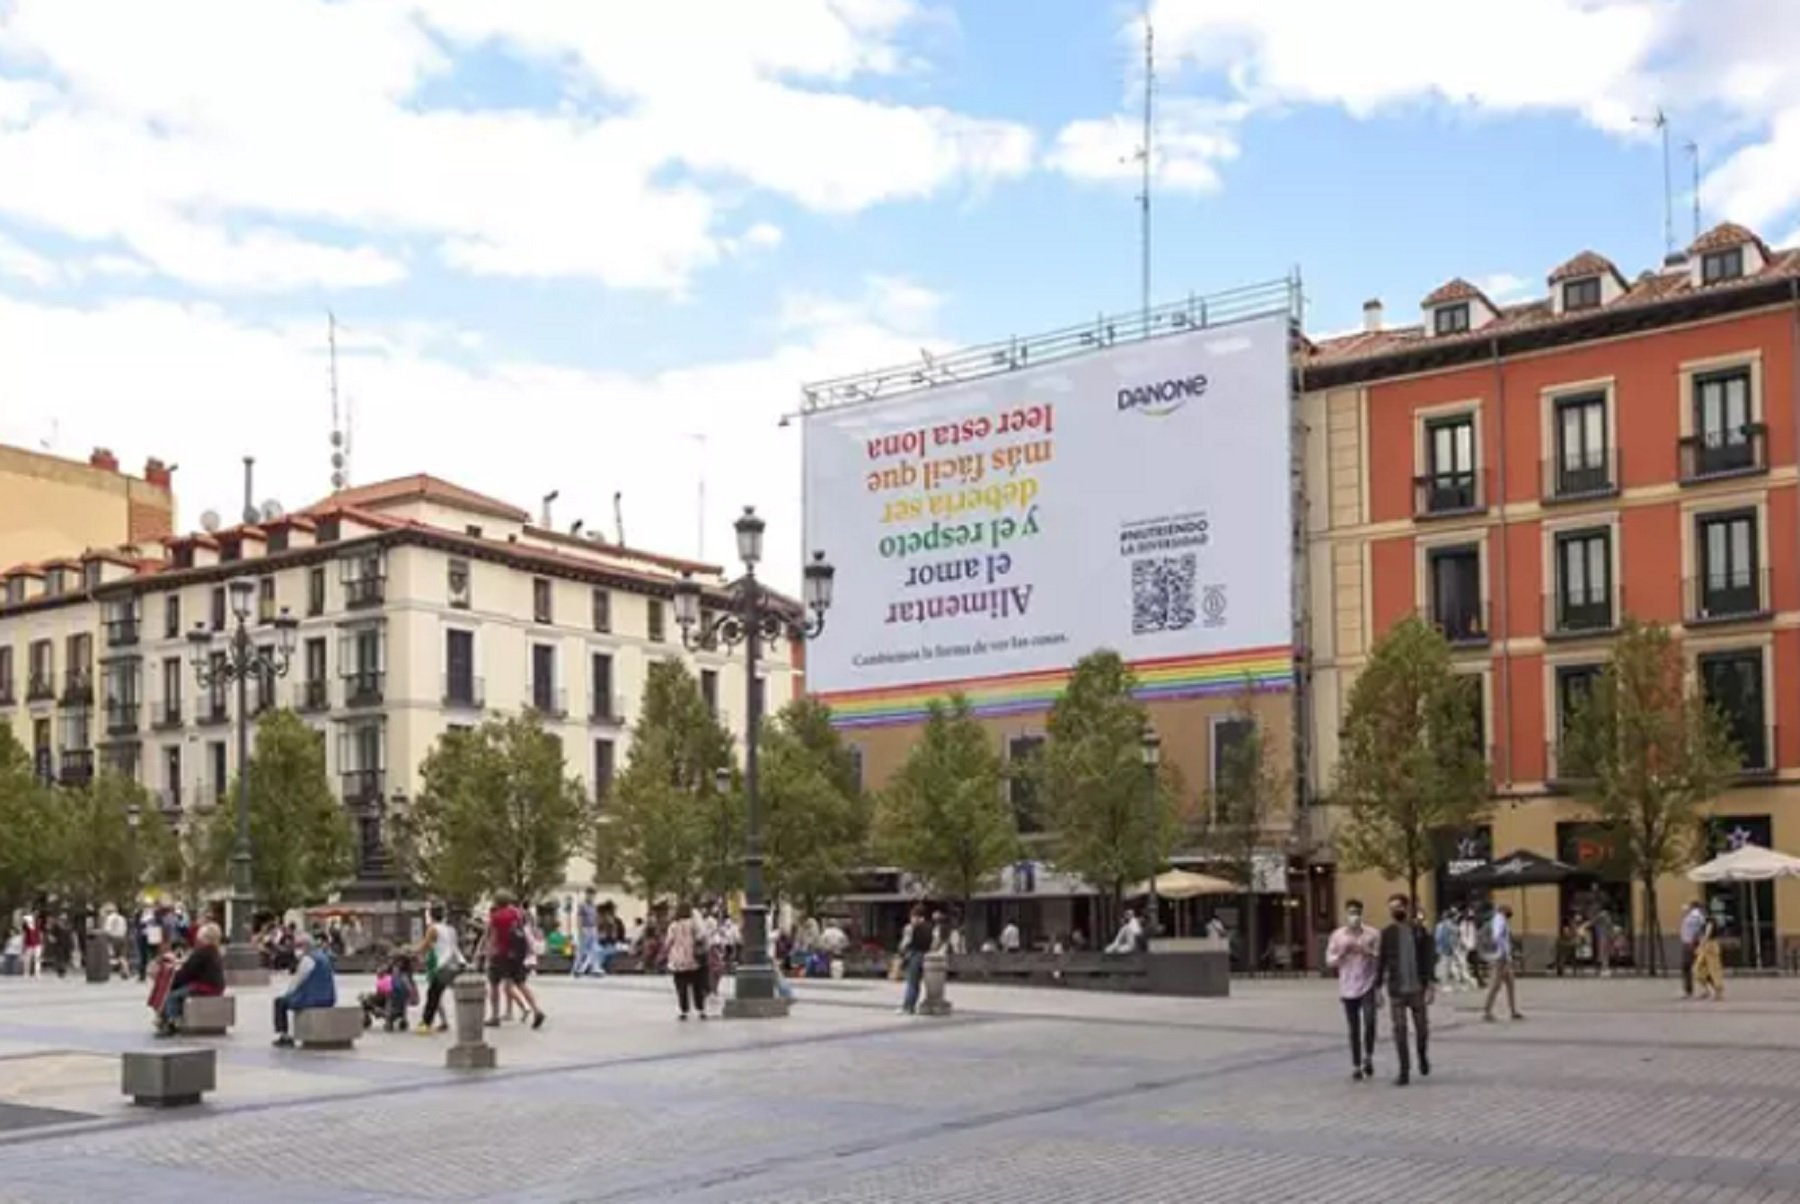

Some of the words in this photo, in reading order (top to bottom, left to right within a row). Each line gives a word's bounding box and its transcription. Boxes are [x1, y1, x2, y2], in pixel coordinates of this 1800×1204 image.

[932, 416, 992, 445] esta
[996, 403, 1054, 433] leer
[867, 429, 926, 459] lona
[991, 440, 1054, 475] más
[866, 460, 917, 491] que
[923, 453, 985, 490] fácil
[880, 498, 922, 523] ser
[1021, 504, 1040, 535] y
[878, 522, 983, 558] respeto
[991, 516, 1016, 548] el
[904, 559, 980, 587] amor
[985, 553, 1012, 584] el
[884, 584, 1033, 624] Alimentar
